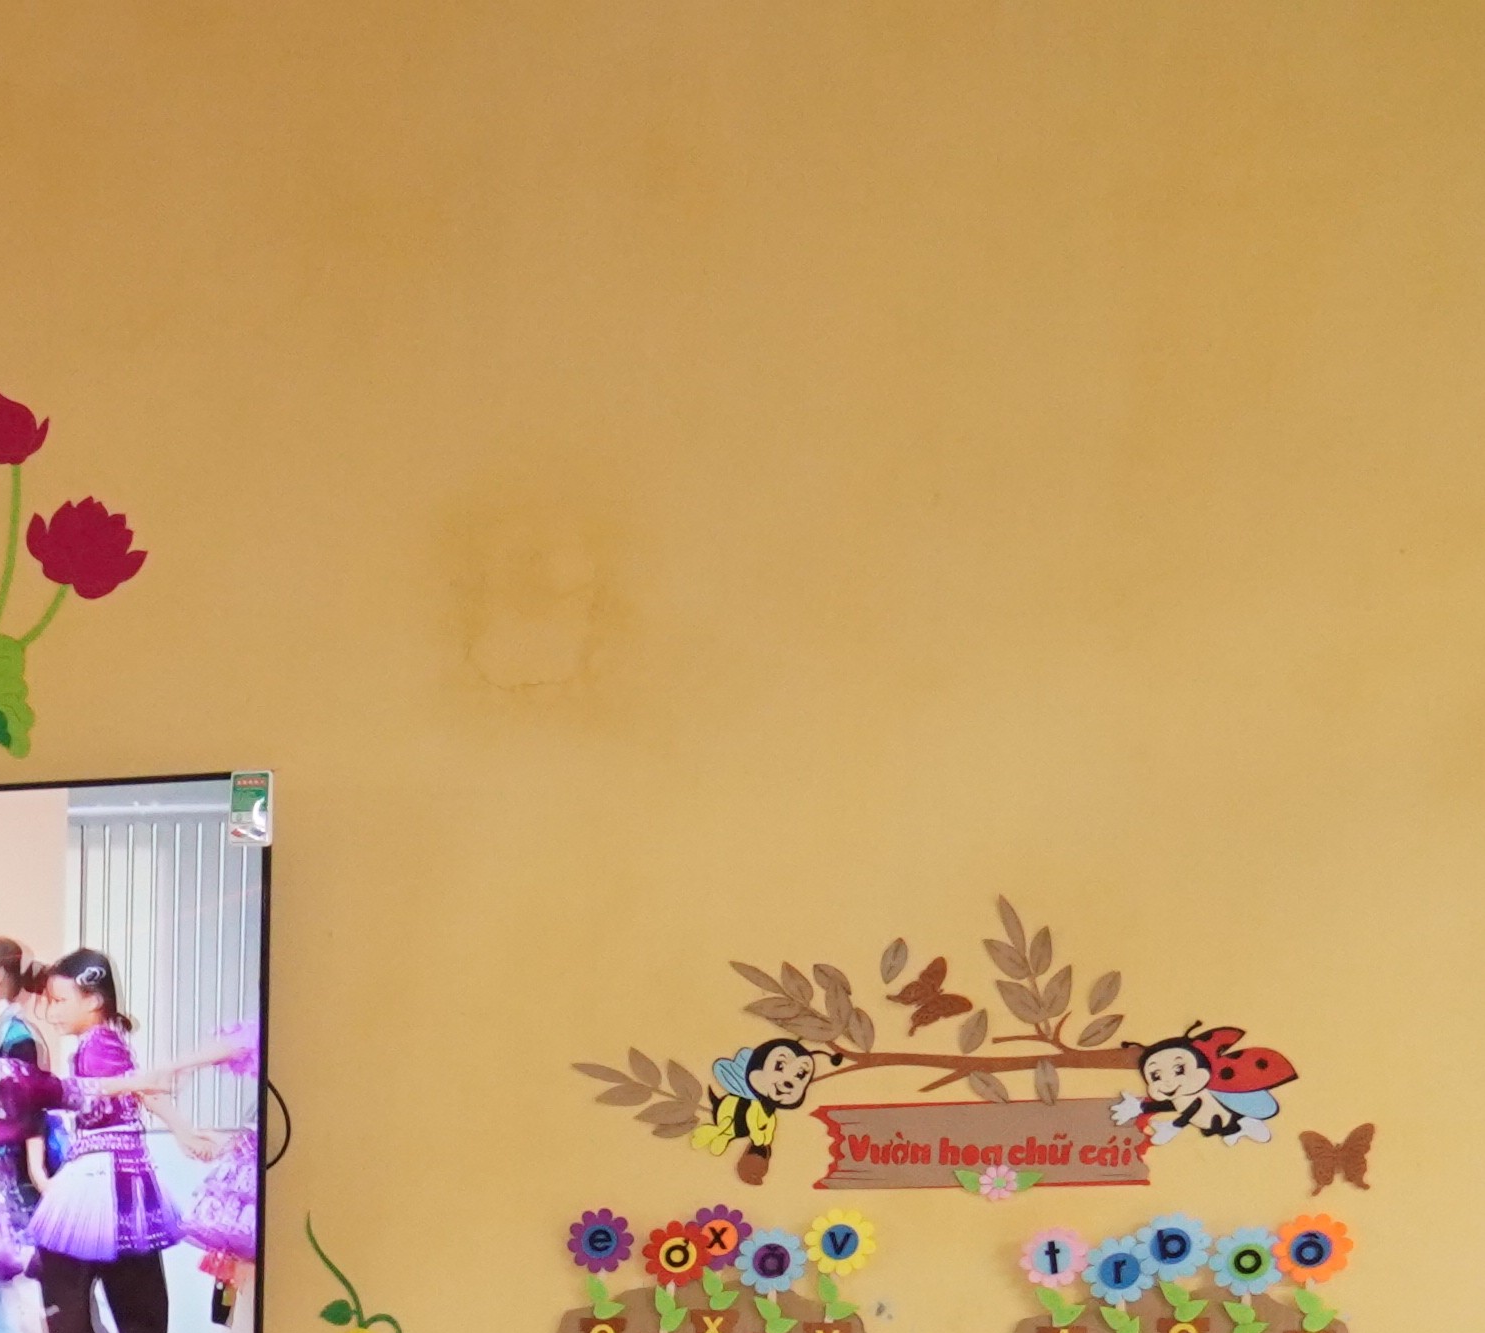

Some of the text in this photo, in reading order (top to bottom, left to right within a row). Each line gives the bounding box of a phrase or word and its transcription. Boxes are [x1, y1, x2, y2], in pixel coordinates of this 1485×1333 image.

[847, 1132, 1132, 1167] Vườn hoa chữ cái
[588, 1229, 614, 1253] e
[706, 1226, 729, 1250] x
[829, 1230, 853, 1254] v
[1044, 1229, 1324, 1284] t r b o ô
